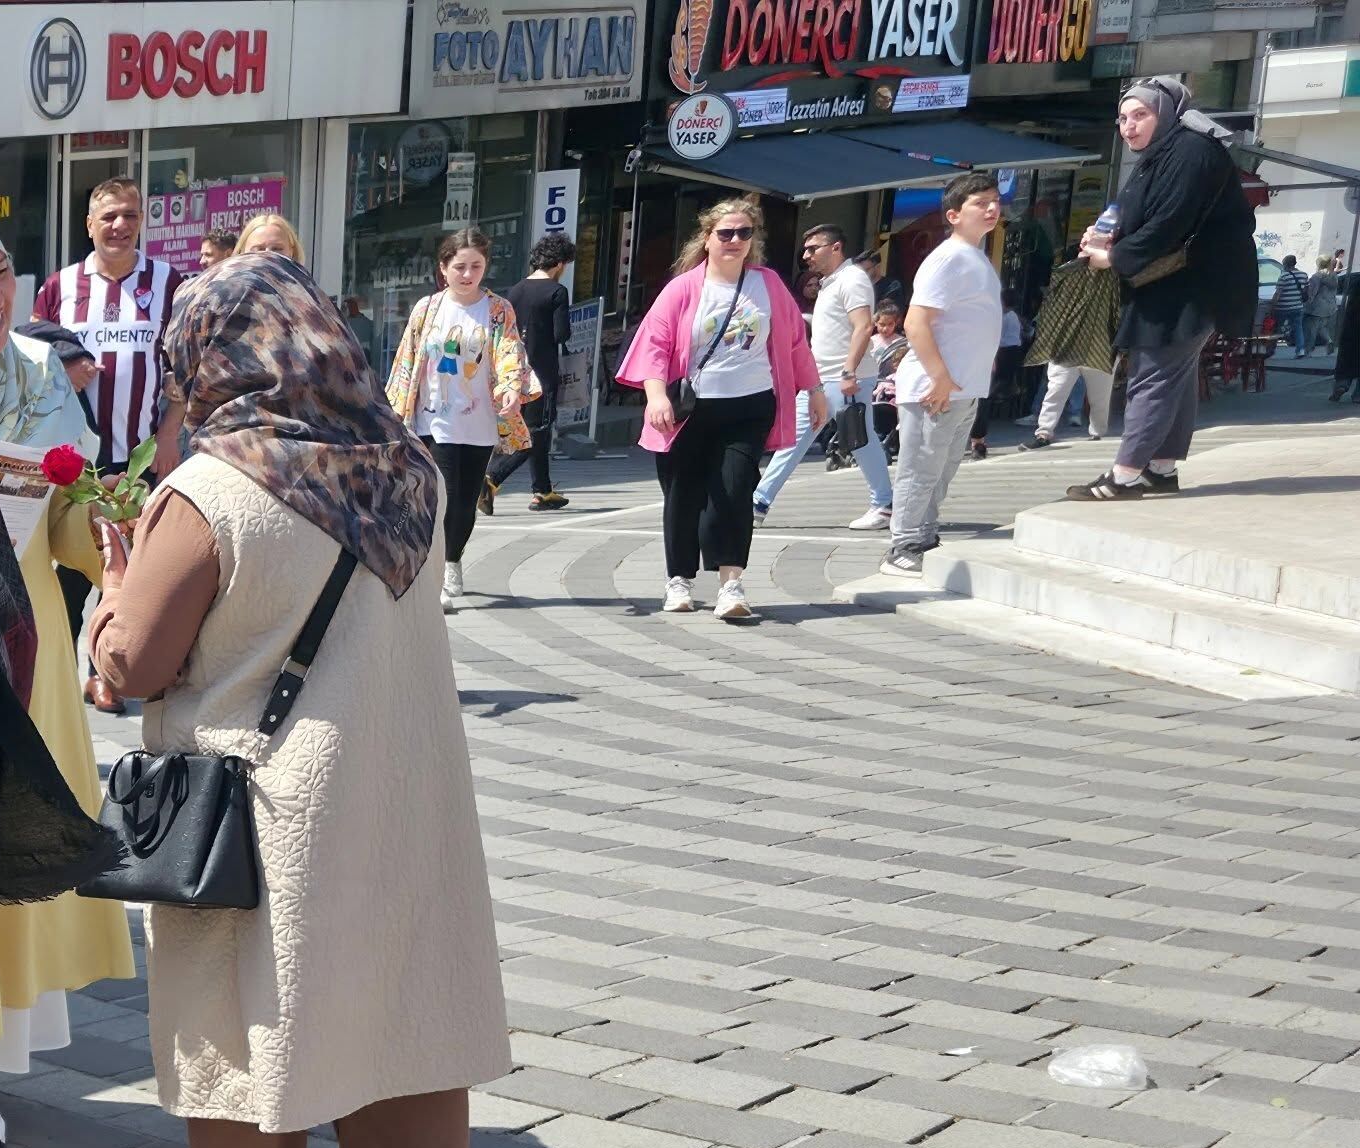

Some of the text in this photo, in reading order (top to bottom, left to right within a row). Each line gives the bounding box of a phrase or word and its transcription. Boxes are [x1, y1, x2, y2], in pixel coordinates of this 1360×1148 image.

[867, 0, 964, 67] YASER
[433, 16, 635, 83] FOTO AYHAN
[106, 29, 268, 101] BOSCH
[786, 94, 866, 121] Lezzetin Adresi
[676, 116, 723, 130] DÖNERCİ
[675, 131, 720, 146] YASER
[228, 188, 264, 207] BOSCH
[95, 327, 154, 346] ÇİMENTO
